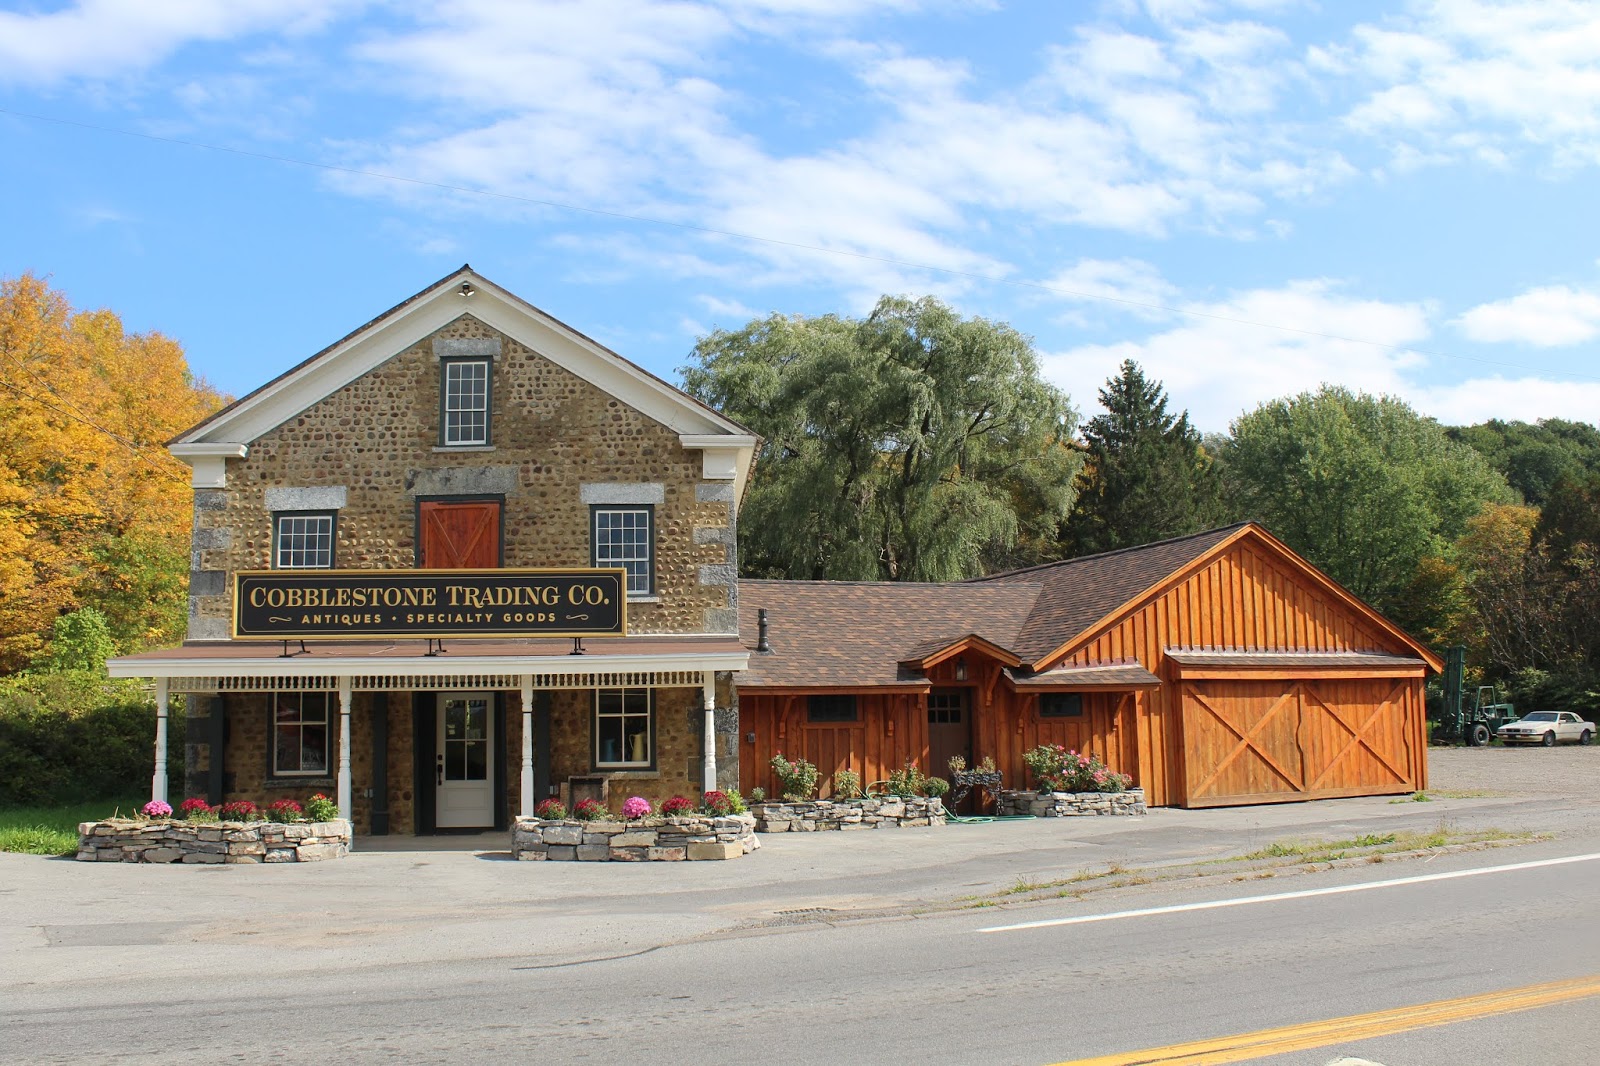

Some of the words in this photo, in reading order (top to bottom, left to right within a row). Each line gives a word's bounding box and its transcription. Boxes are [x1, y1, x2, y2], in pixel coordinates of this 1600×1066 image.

[250, 586, 436, 608] COBBLESTONE
[446, 585, 560, 608] TRADING
[568, 584, 610, 606] CO.
[301, 613, 382, 626] ANTIQUES
[407, 612, 493, 623] SPECIALTY
[503, 612, 556, 623] GOODS
